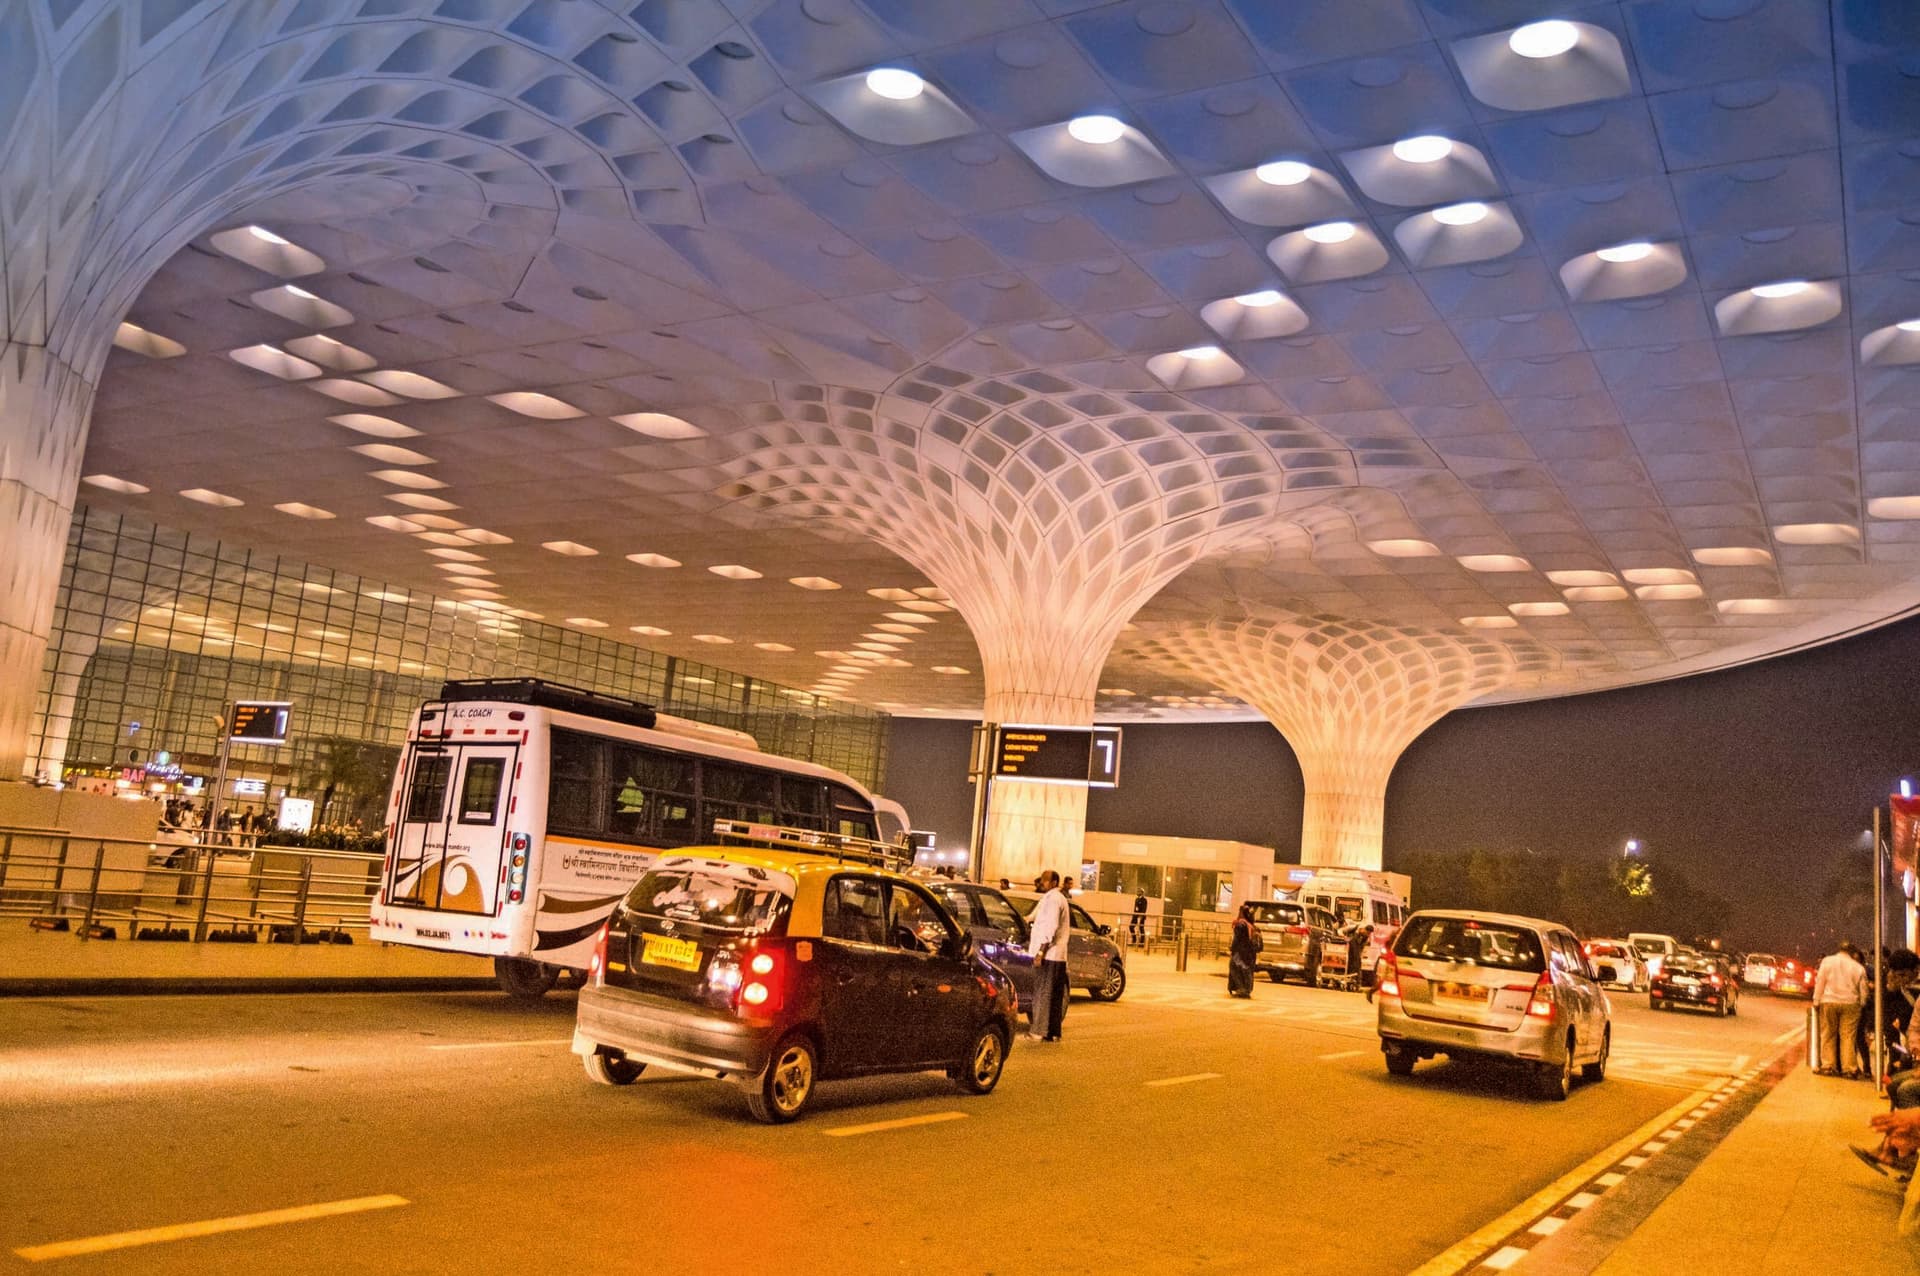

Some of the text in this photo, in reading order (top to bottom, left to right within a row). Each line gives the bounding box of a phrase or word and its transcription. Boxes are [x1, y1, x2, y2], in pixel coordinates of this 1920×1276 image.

[468, 709, 493, 718] COACH
[1096, 740, 1113, 773] 7
[122, 768, 145, 782] BAR
